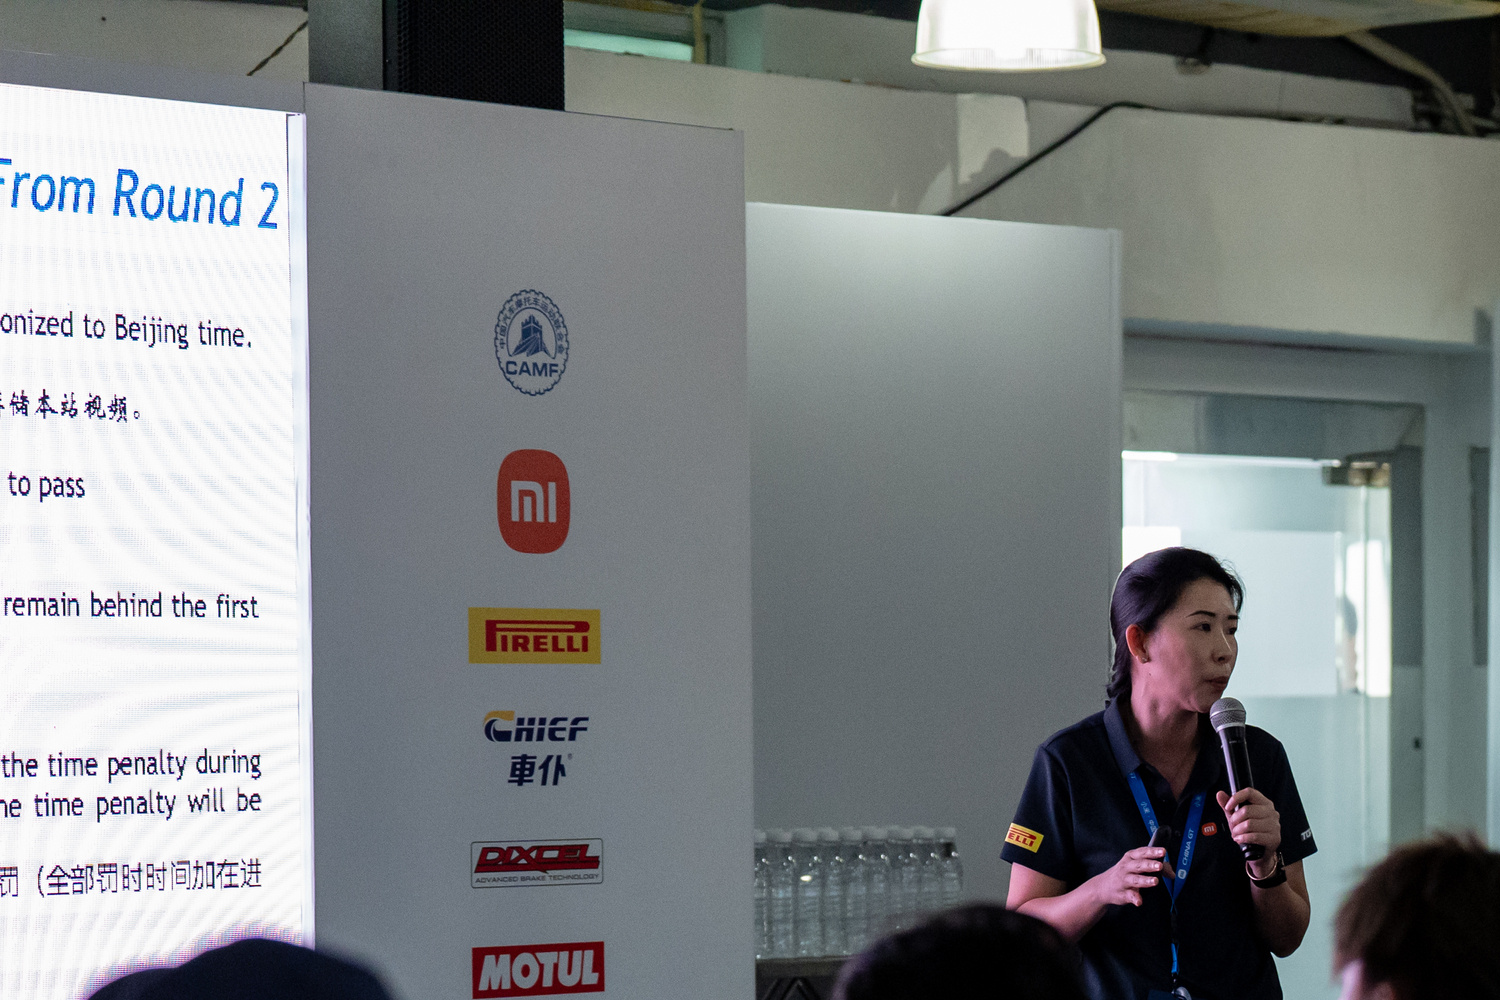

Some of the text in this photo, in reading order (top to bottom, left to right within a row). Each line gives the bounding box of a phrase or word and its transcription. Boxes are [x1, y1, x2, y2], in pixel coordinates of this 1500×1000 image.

[113, 168, 244, 227] Round
[258, 182, 279, 229] 2
[0, 310, 251, 350] onized to Beijing time.
[505, 360, 559, 378] CAMF
[8, 471, 86, 503] to pass
[5, 591, 259, 618] remain behind the first
[485, 619, 590, 652] PIRELLI
[483, 710, 589, 742] CHIEF
[1, 748, 261, 783] the time penalty during
[34, 792, 84, 818] time
[97, 789, 176, 823] penalty
[188, 787, 225, 812] will
[238, 788, 261, 812] be
[1007, 827, 1037, 847] PELLI
[1182, 828, 1195, 866] CHINA GT
[474, 844, 600, 873] DIXCEL
[475, 876, 518, 884] ADVANCED
[548, 873, 599, 881] TECHNOLOGY
[478, 950, 599, 991] MOTUL
